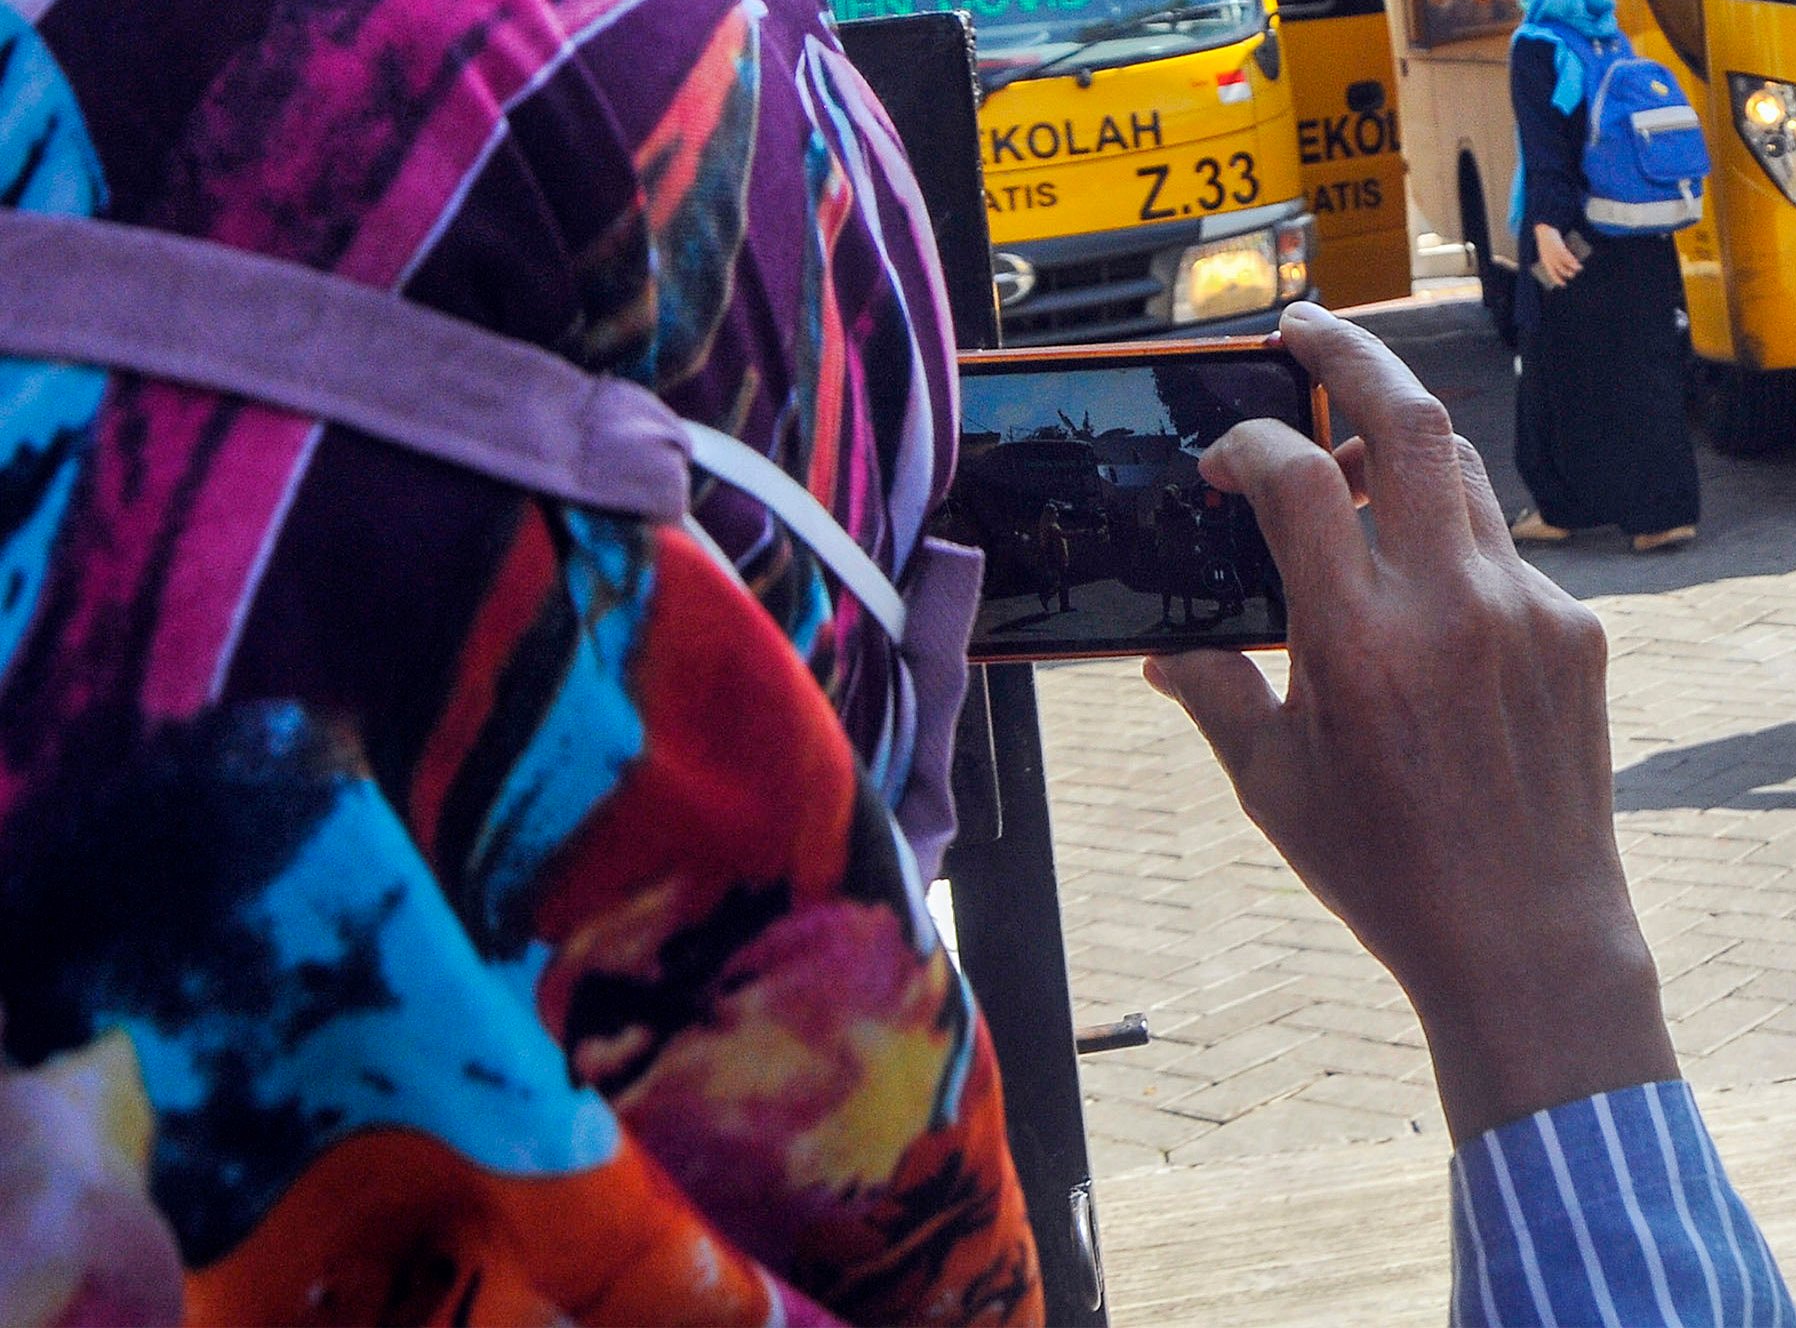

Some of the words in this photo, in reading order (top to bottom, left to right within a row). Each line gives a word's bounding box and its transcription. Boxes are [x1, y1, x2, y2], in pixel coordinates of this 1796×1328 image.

[979, 109, 1162, 164] KOLAH
[1298, 111, 1400, 164] EKOL
[985, 182, 1057, 213] ATIS
[1137, 151, 1260, 221] Z.33
[1308, 177, 1382, 215] ATIS
